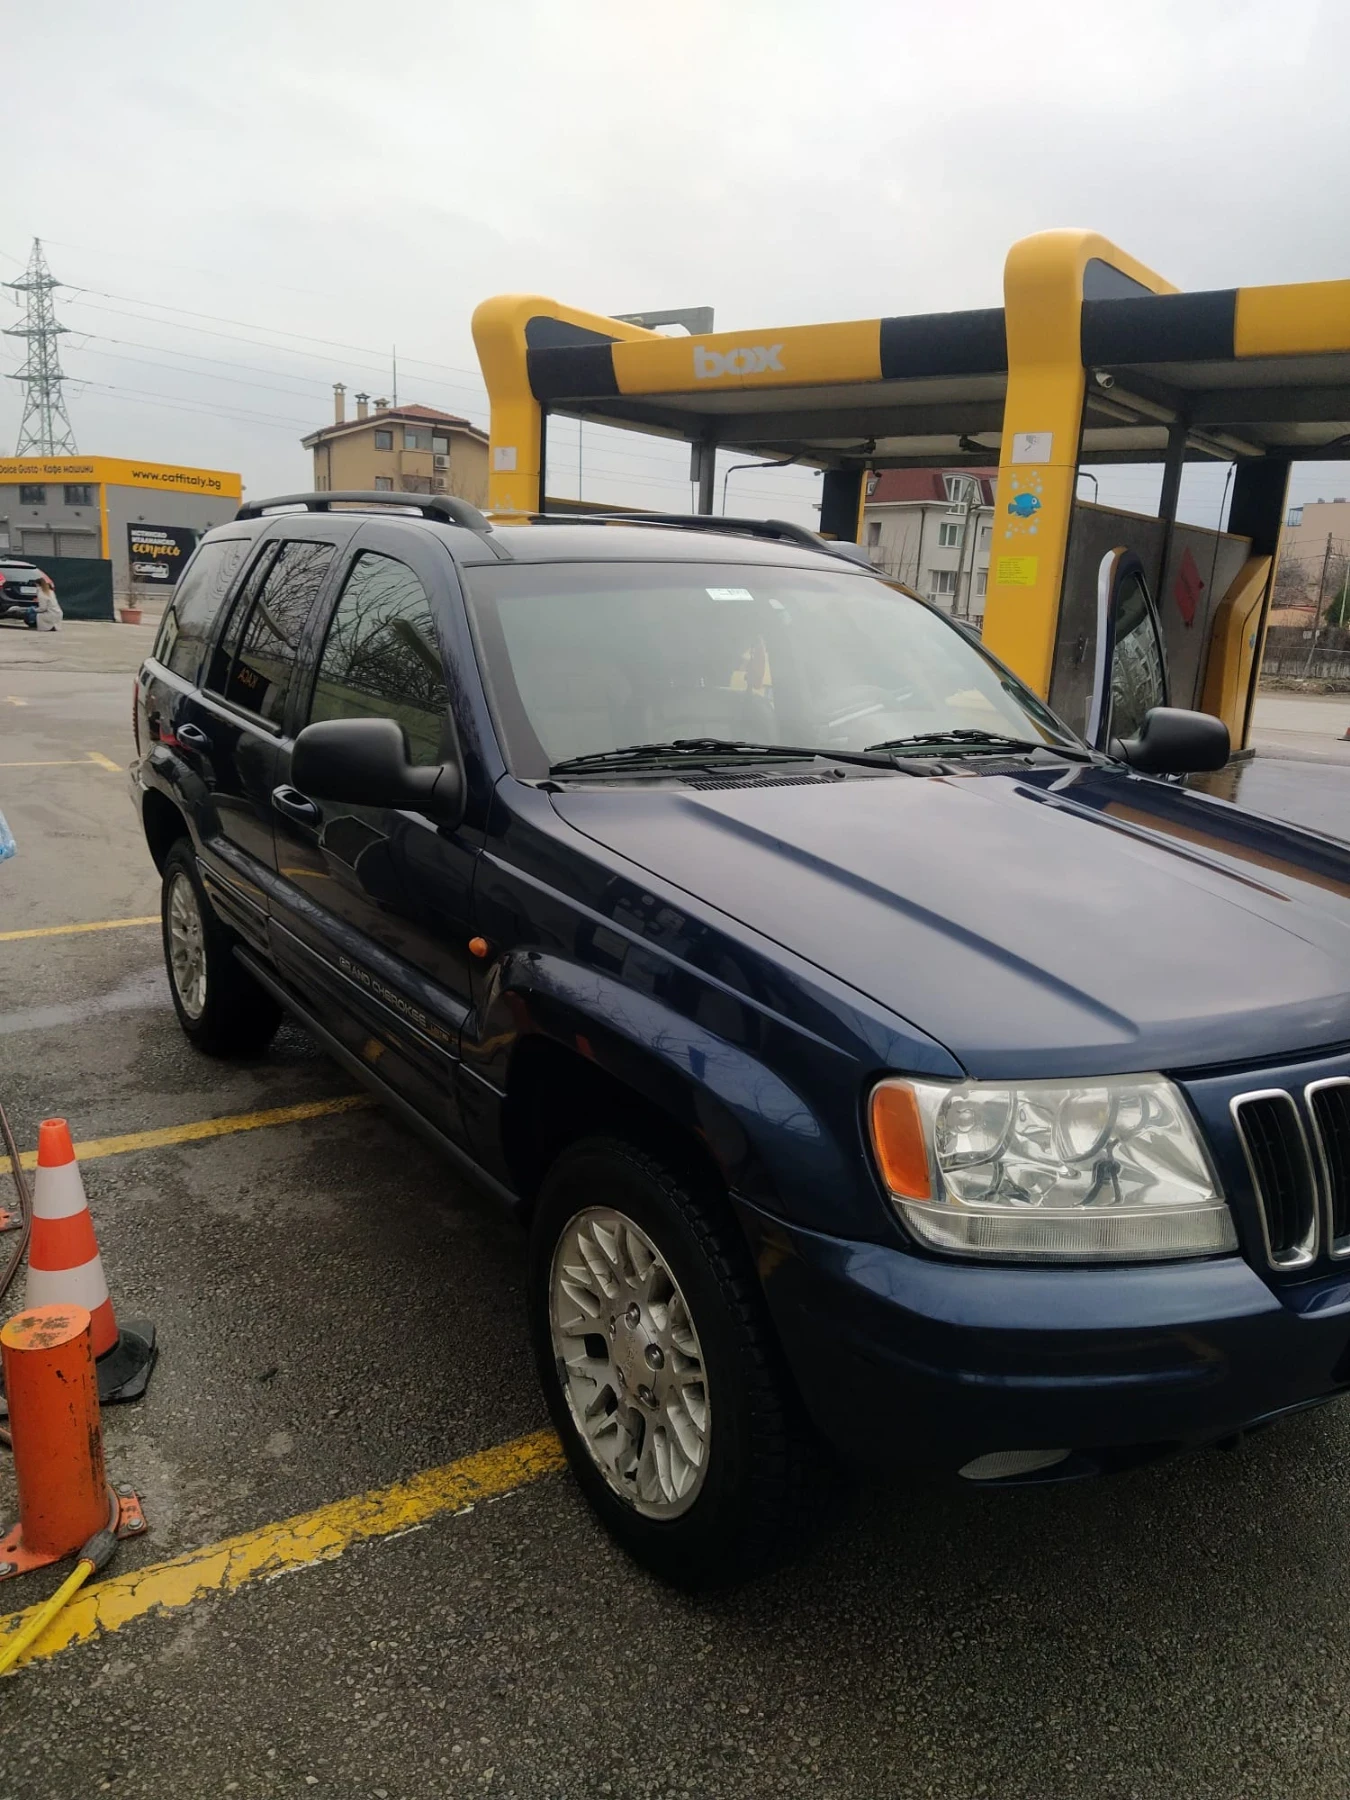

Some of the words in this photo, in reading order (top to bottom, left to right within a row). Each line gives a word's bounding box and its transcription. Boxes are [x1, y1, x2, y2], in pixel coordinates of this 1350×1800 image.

[693, 344, 786, 379] box
[18, 465, 39, 474] Gusto
[132, 470, 222, 490] www.caffitaly.bg
[372, 981, 428, 1028] CHEROKEE
